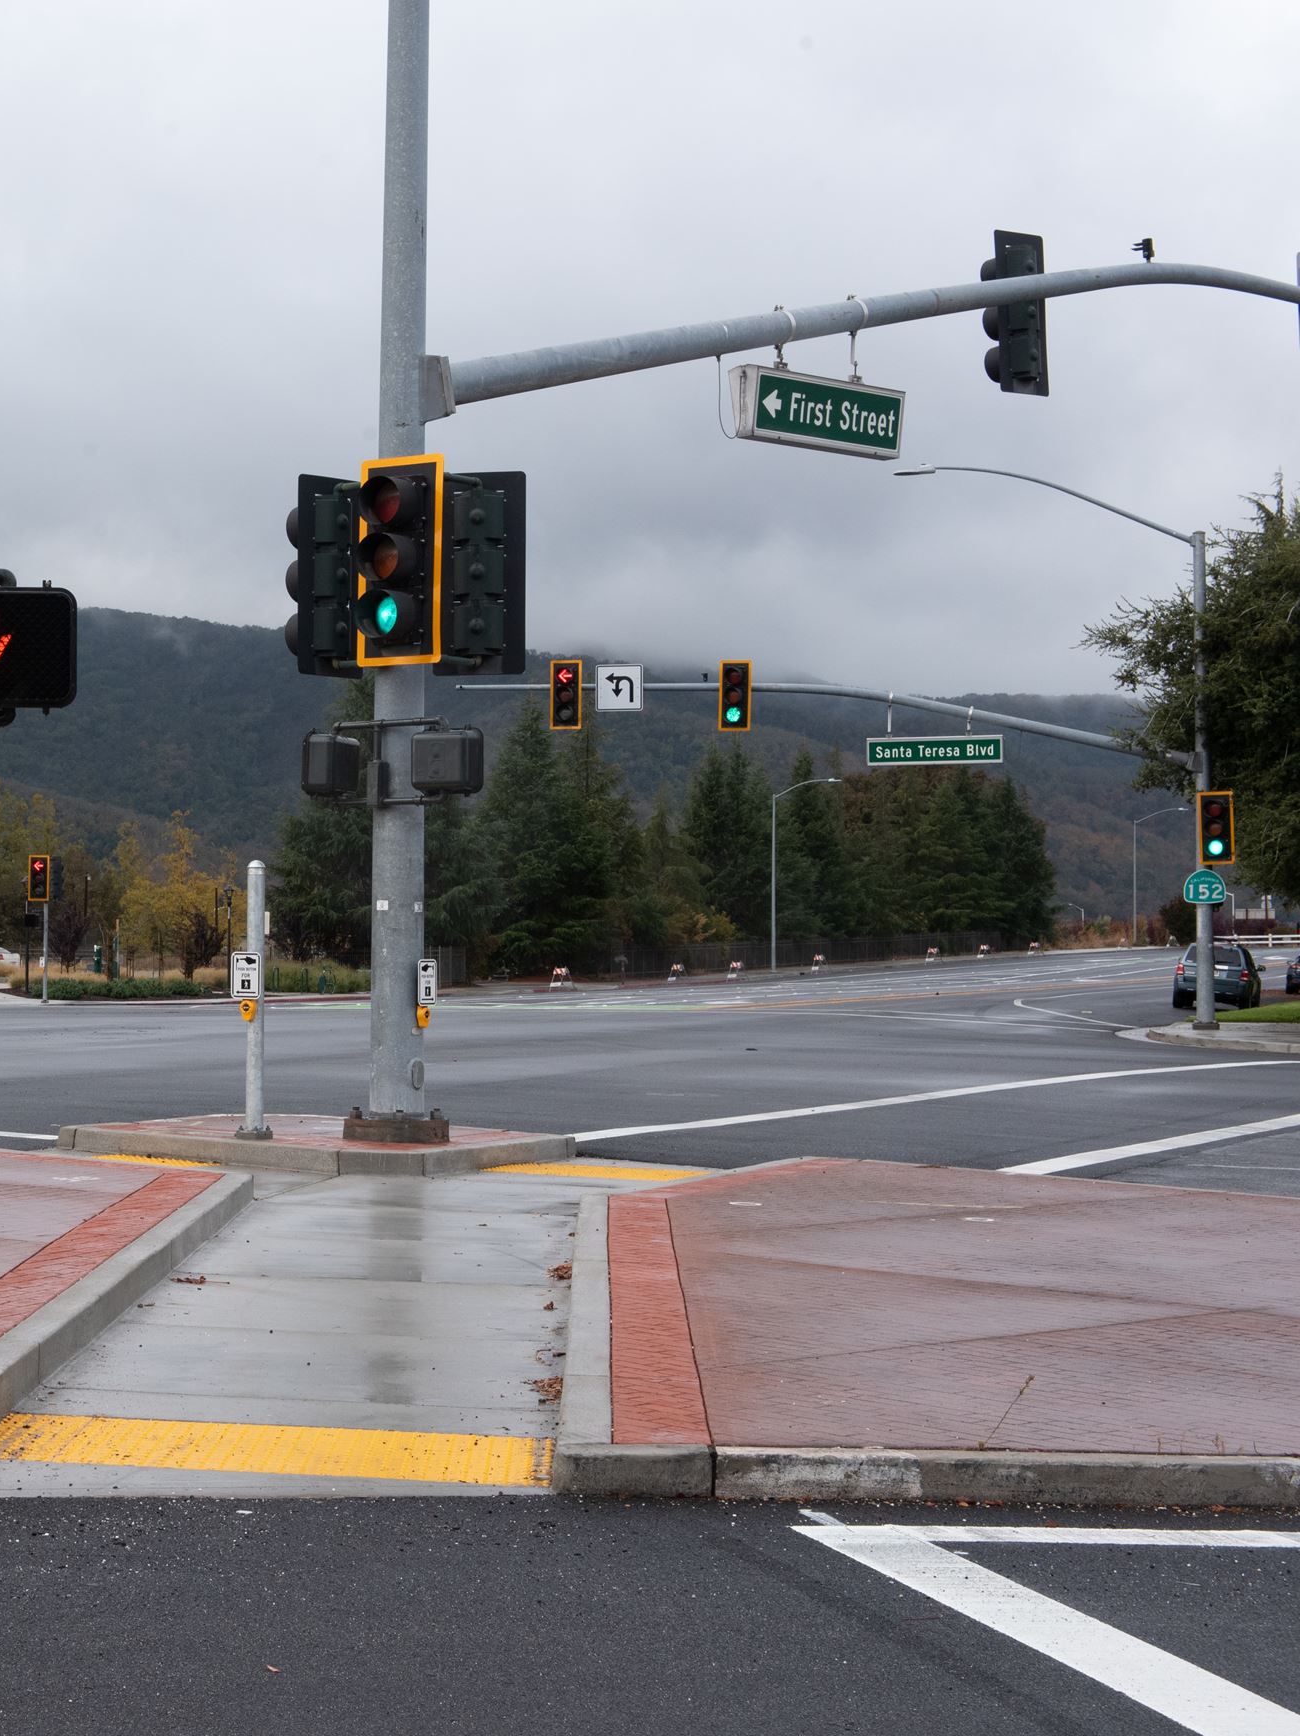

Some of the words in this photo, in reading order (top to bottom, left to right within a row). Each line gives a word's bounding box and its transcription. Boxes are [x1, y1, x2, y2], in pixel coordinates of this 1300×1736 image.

[789, 392, 833, 428] First
[839, 401, 896, 438] Street
[875, 746, 913, 759] Santa
[918, 745, 960, 758] Teresa
[966, 743, 995, 757] Blvd
[1188, 883, 1224, 900] 152
